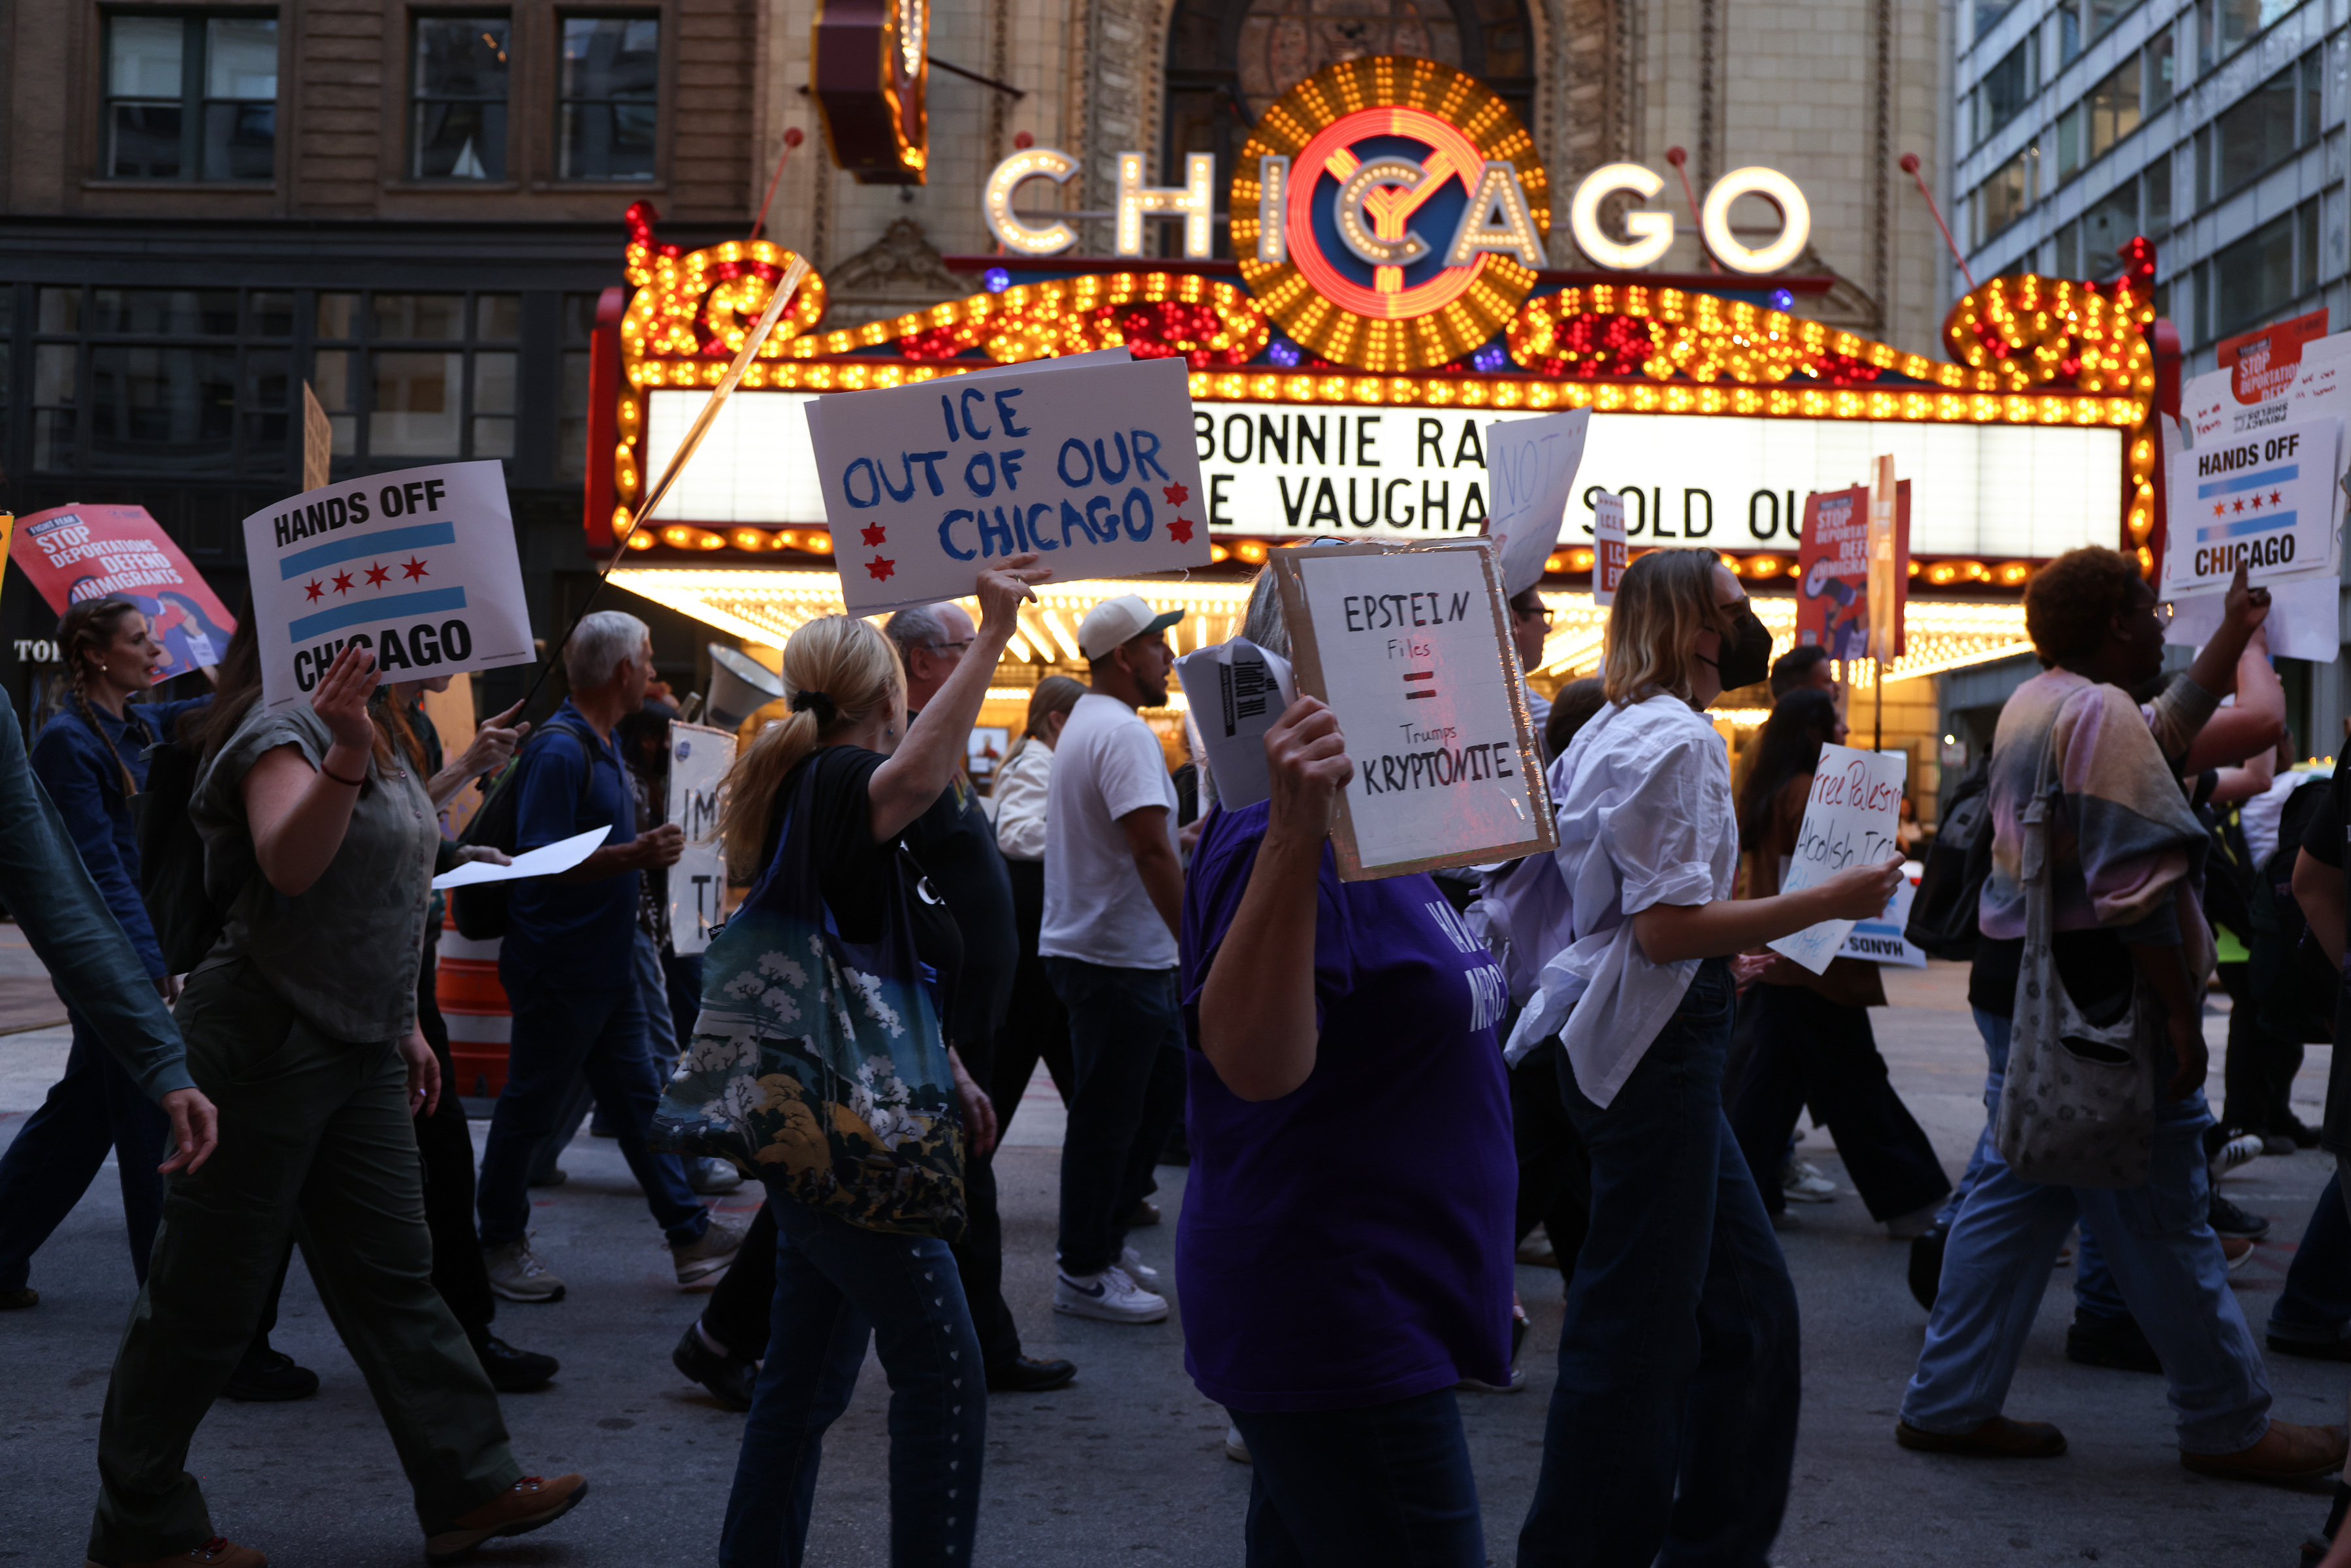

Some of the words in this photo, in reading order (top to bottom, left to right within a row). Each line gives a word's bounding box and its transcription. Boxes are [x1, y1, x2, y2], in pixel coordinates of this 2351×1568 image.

[983, 148, 1810, 274] CHICAGO
[2239, 351, 2271, 379] STOP
[941, 387, 1031, 443] ICE
[1192, 411, 1381, 467] BONNIE
[1418, 417, 1489, 469] RA
[2198, 443, 2259, 477] HANDS
[2265, 434, 2300, 462] OFF
[842, 451, 948, 509] OUT
[964, 449, 1026, 498] OF
[1057, 428, 1172, 488] OUR
[274, 492, 370, 548] HANDS
[381, 479, 445, 518] OFF
[937, 487, 1155, 562] CHICAGO
[1277, 477, 1488, 531] VAUGHA
[1582, 485, 1712, 537] SOLD
[1749, 489, 1802, 539] OU
[1816, 507, 1853, 529] STOP
[36, 525, 90, 554] STOP
[48, 539, 158, 569] DEPORTATIONS
[2195, 533, 2295, 577] CHICAGO
[73, 569, 184, 601] IMMIGRANTS
[99, 552, 172, 574] DEFEND
[1344, 591, 1469, 632] EPSTEIN
[1387, 639, 1431, 659] Files
[1234, 661, 1265, 697] PEOPLE
[1236, 697, 1266, 720] THE
[1399, 722, 1457, 747] Trumps
[1362, 742, 1513, 796] KRYPTONITE
[1810, 754, 1846, 805] Free
[684, 788, 717, 841] IM
[1795, 816, 1854, 869] Abolish
[1849, 936, 1904, 957] HANDS
[1463, 963, 1508, 1032] MERC
